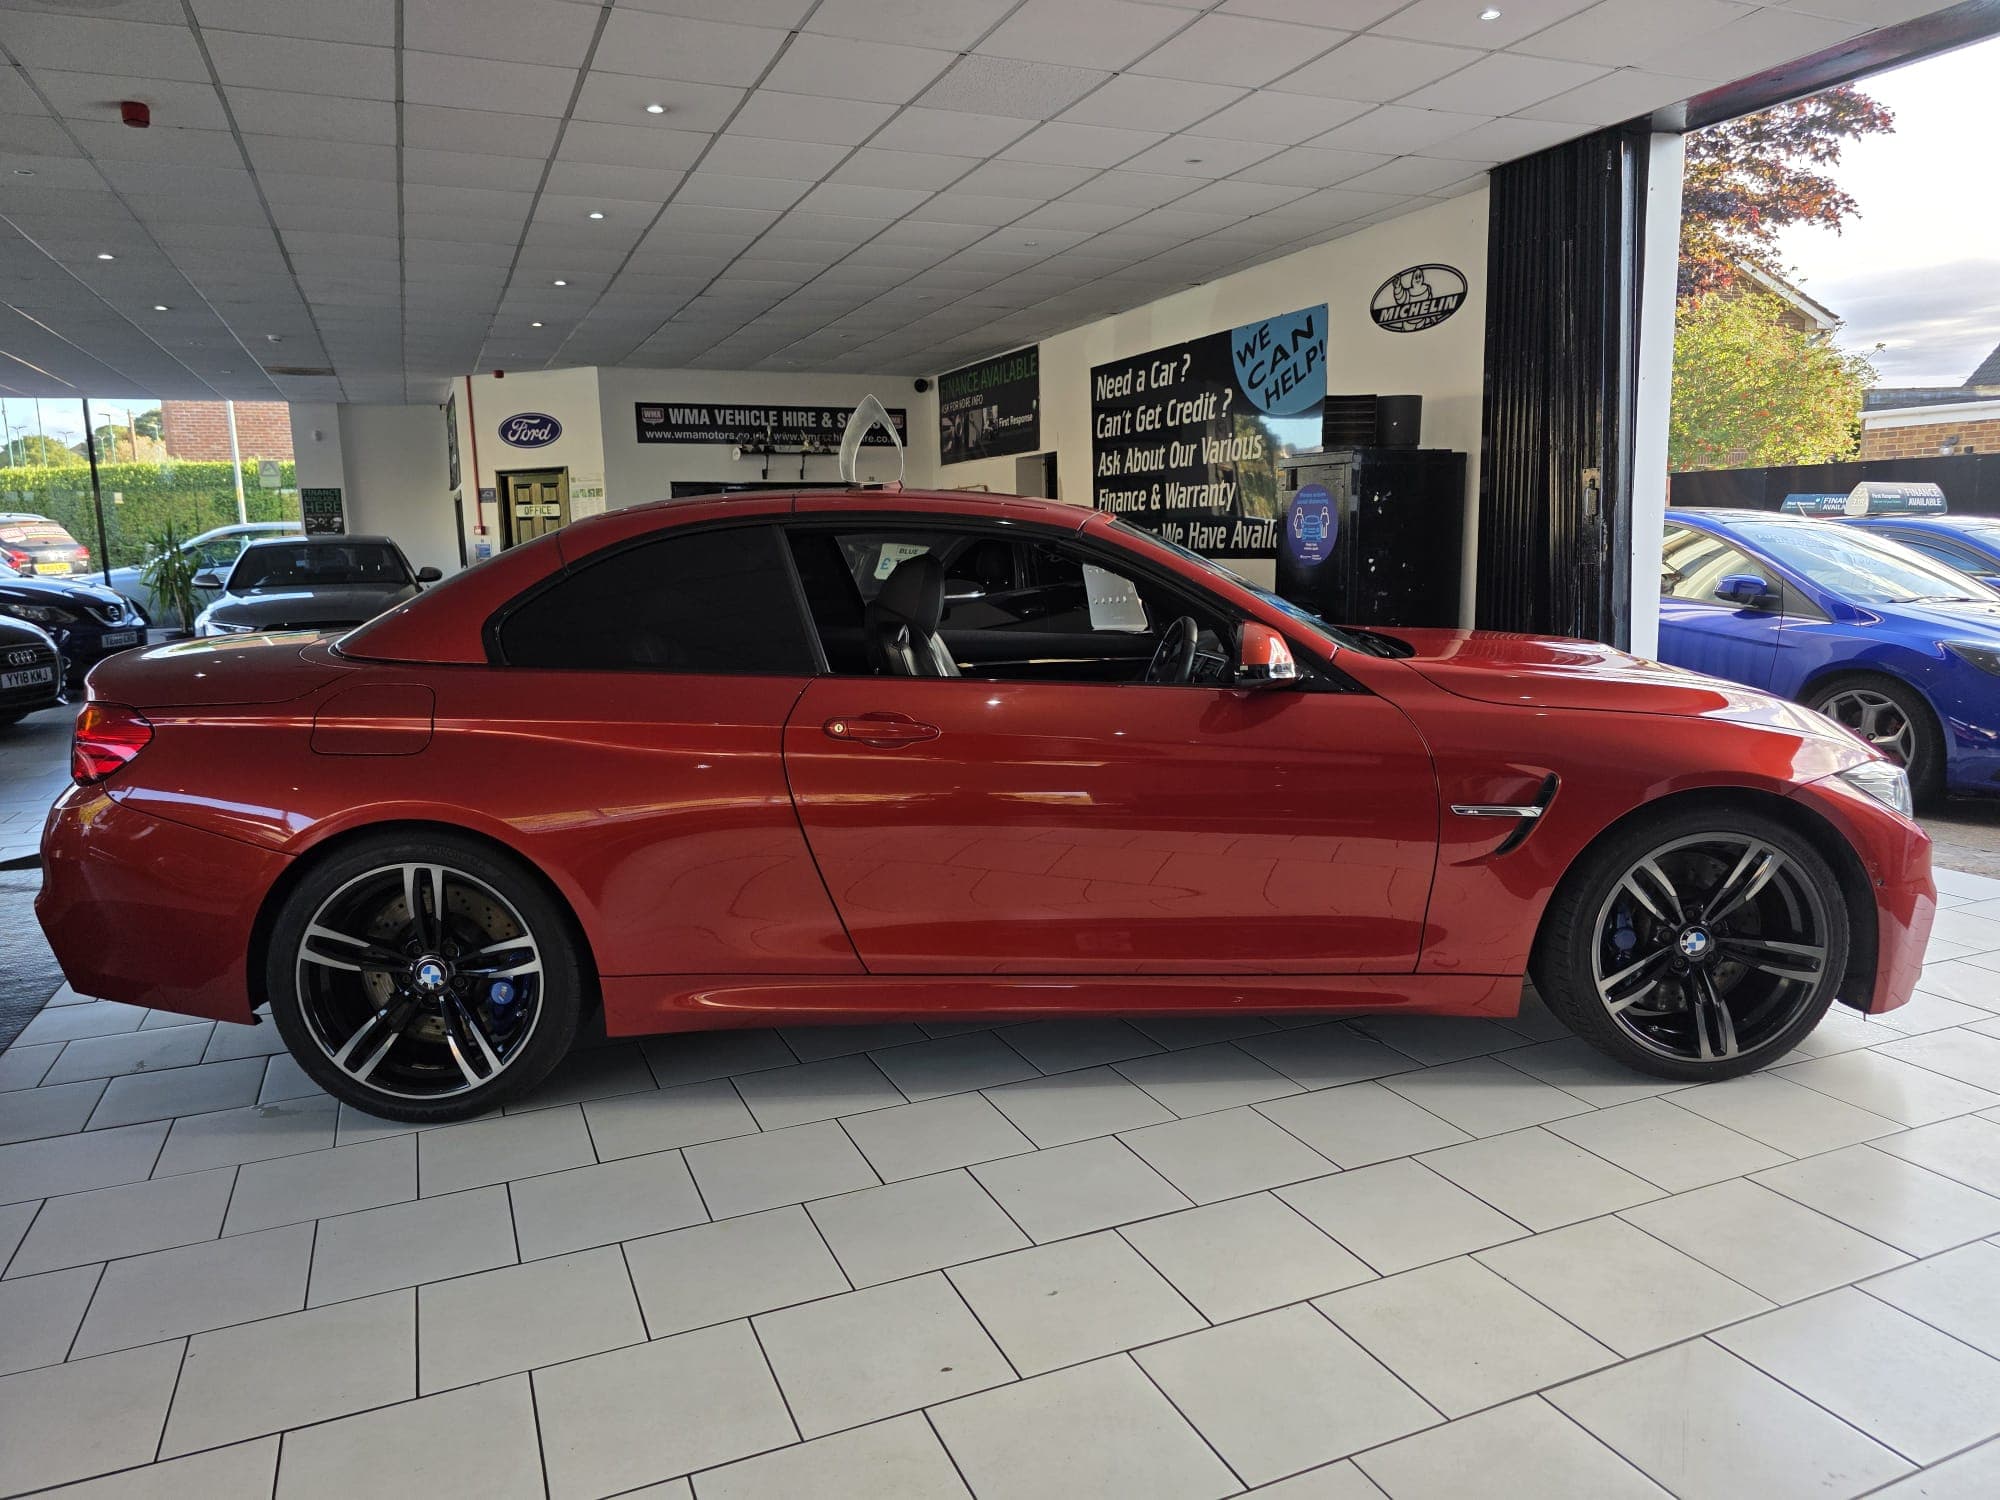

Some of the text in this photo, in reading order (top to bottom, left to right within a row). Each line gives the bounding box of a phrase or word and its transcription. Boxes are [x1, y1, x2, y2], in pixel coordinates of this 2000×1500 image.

[1380, 295, 1458, 322] MICHELIN
[1236, 322, 1271, 368] WE
[1248, 314, 1314, 390] CAN
[941, 353, 1037, 399] FINANCE AVAILABLE
[1096, 354, 1191, 402] Need a Car ?
[1264, 339, 1326, 410] HELP!
[668, 408, 711, 425] WMA
[714, 409, 778, 426] VEHICLE
[782, 411, 816, 427] HIRE
[821, 412, 832, 428] &
[999, 413, 1032, 427] First Response
[1096, 388, 1233, 439] Can't Get Credit ?
[507, 418, 552, 442] Ford
[1097, 432, 1262, 477] Ask About Our Various
[1099, 479, 1236, 513] Finance & Warranty
[1904, 488, 1939, 497] FINANCE
[1908, 498, 1942, 506] AVAILABLE
[304, 501, 341, 513] HERE
[524, 505, 552, 516] OFFICE
[1161, 522, 1184, 546] We
[1188, 522, 1226, 549] Have
[6, 669, 48, 686] YY18 KMJ
